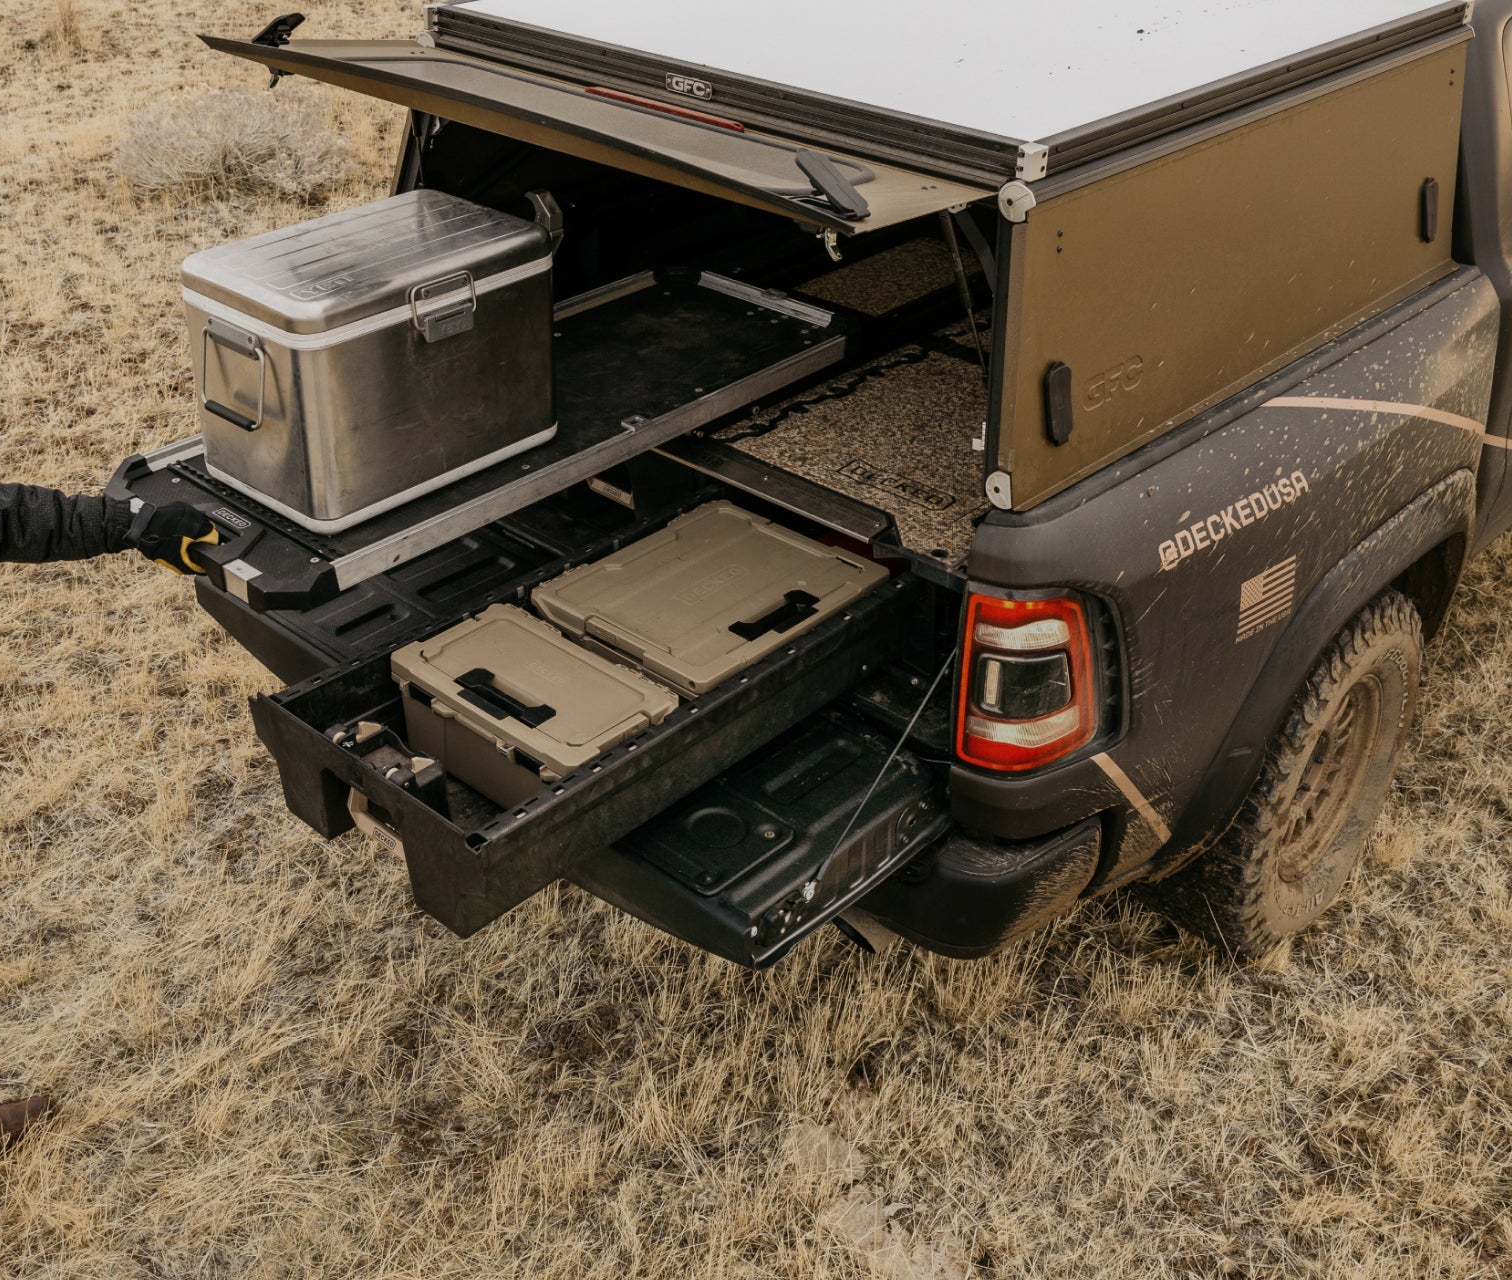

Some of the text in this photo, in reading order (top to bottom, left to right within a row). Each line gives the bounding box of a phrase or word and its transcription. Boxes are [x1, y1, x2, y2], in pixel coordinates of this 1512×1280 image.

[671, 76, 706, 97] GFC
[300, 276, 354, 296] YETI
[1082, 354, 1144, 412] GFC
[850, 466, 944, 505] DECKED
[217, 509, 247, 527] DECKED
[1158, 470, 1310, 572] @DECKEDUSA
[374, 829, 395, 848] DECKED
